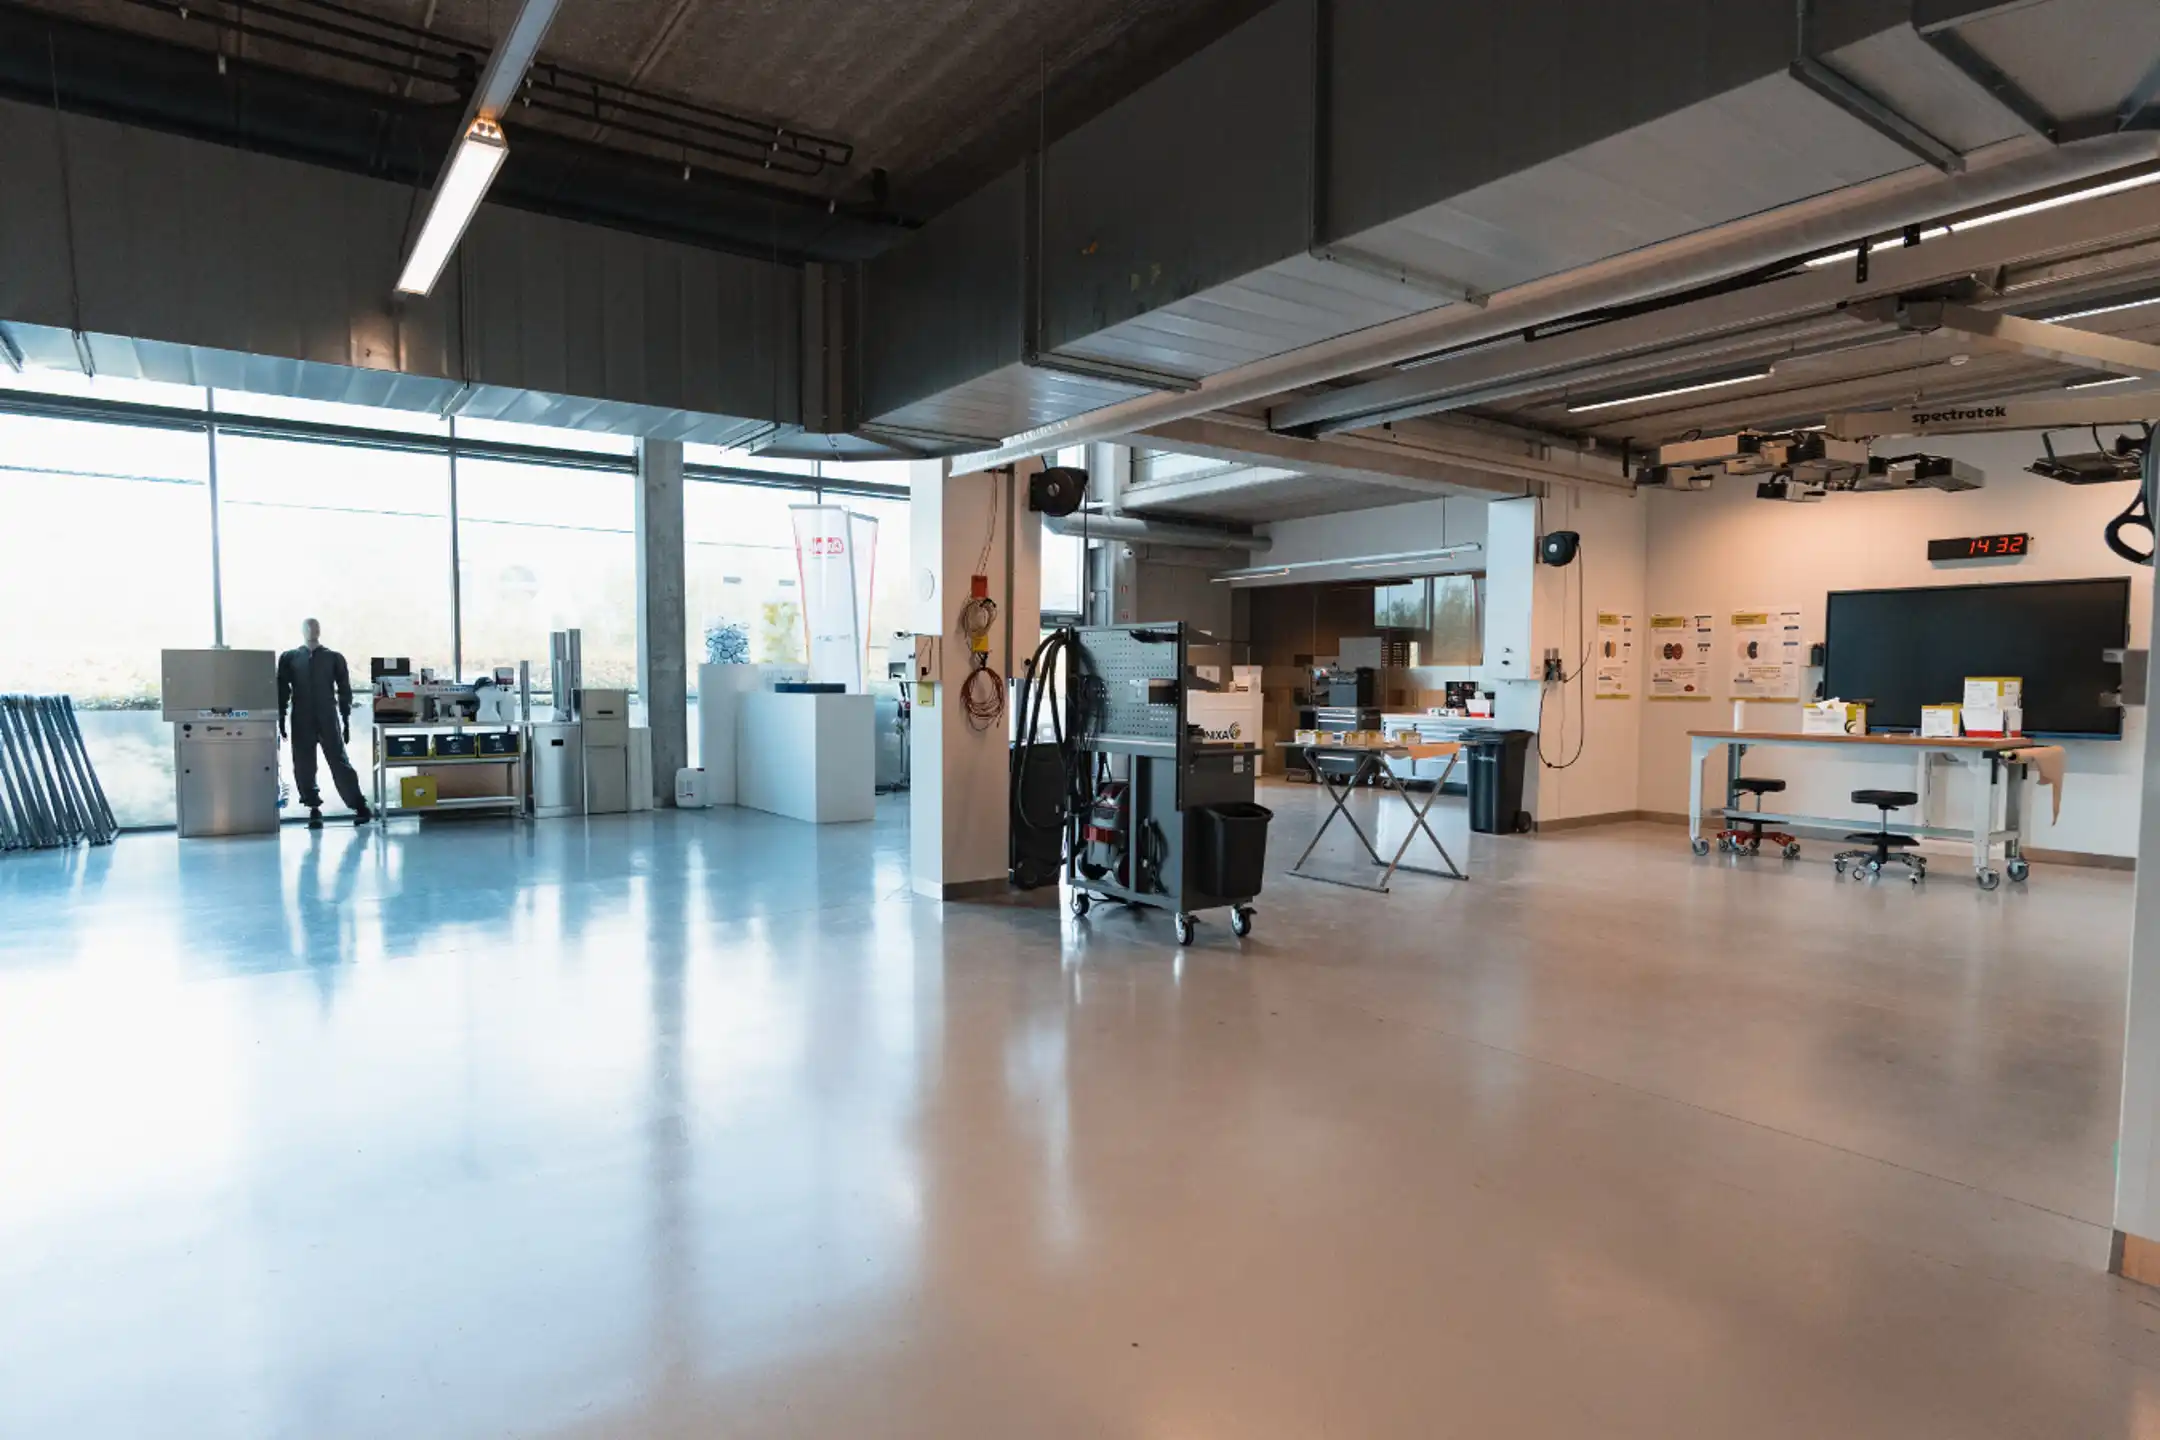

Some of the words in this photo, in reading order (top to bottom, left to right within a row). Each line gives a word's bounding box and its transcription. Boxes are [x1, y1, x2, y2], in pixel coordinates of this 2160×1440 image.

[1912, 406, 2006, 424] spectratek
[1969, 540, 1990, 554] 14
[1996, 536, 2024, 553] 32
